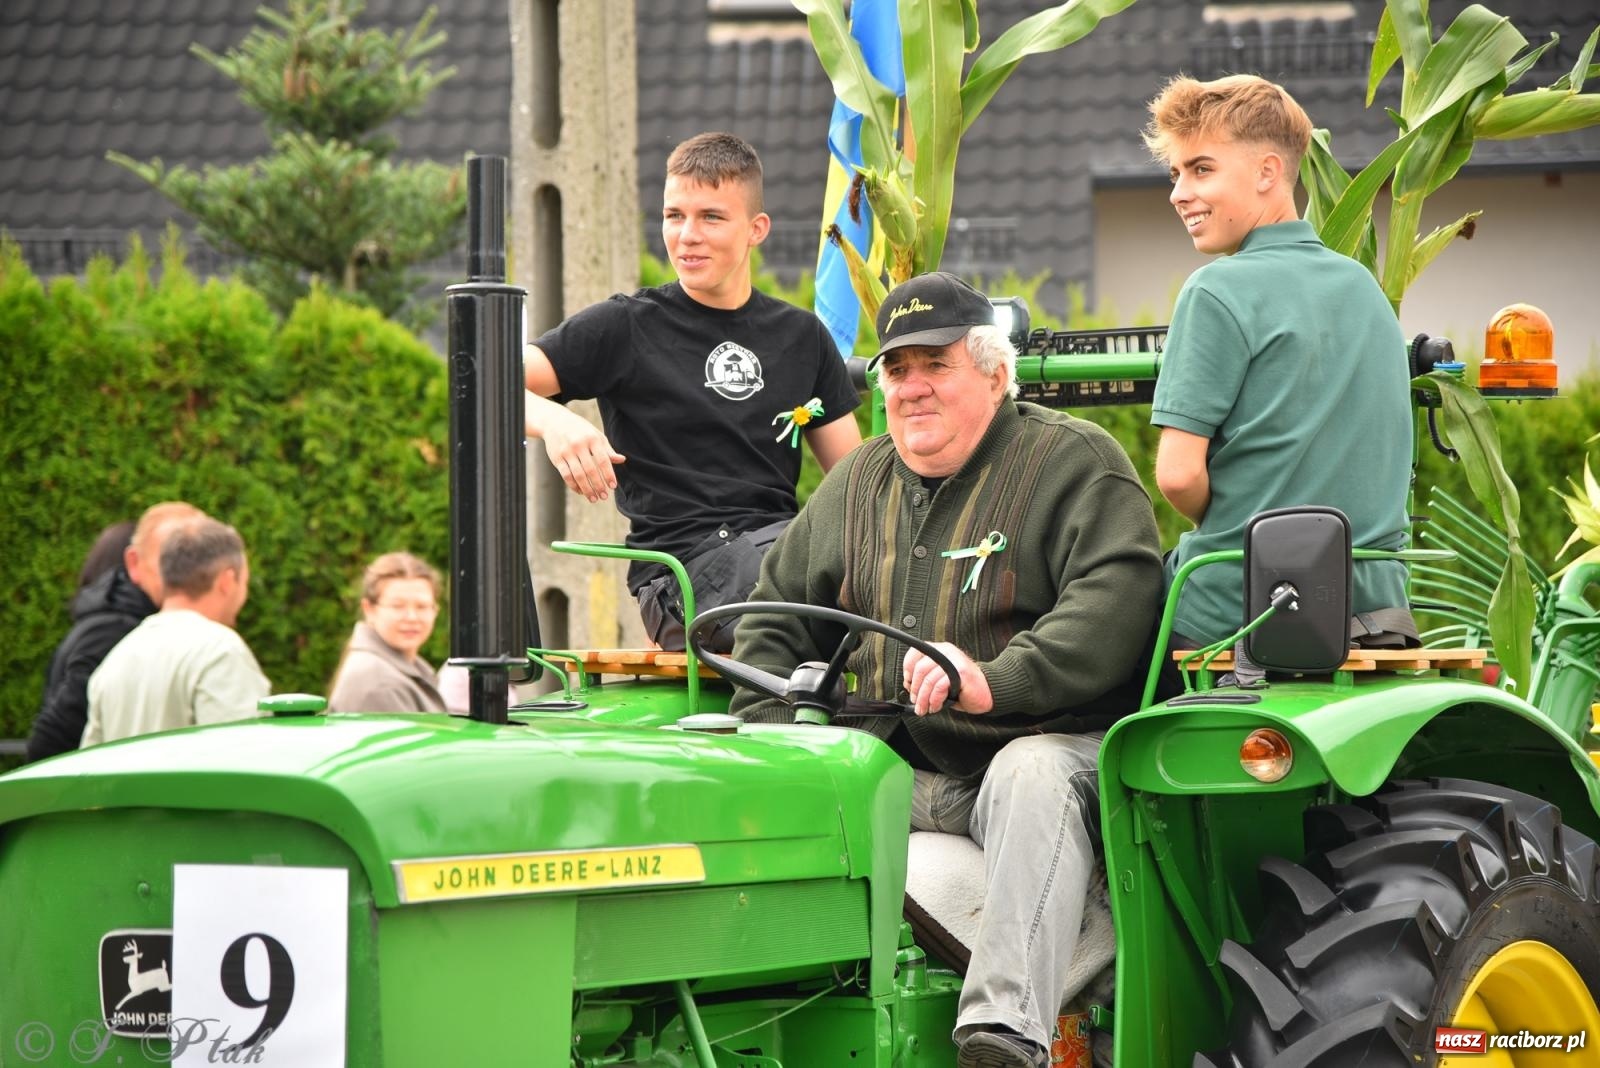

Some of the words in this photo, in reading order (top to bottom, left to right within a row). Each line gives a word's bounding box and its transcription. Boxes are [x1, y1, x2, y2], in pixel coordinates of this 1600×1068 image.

[434, 866, 497, 889] JOHN
[220, 932, 295, 1052] 9
[110, 1012, 146, 1026] JOHN
